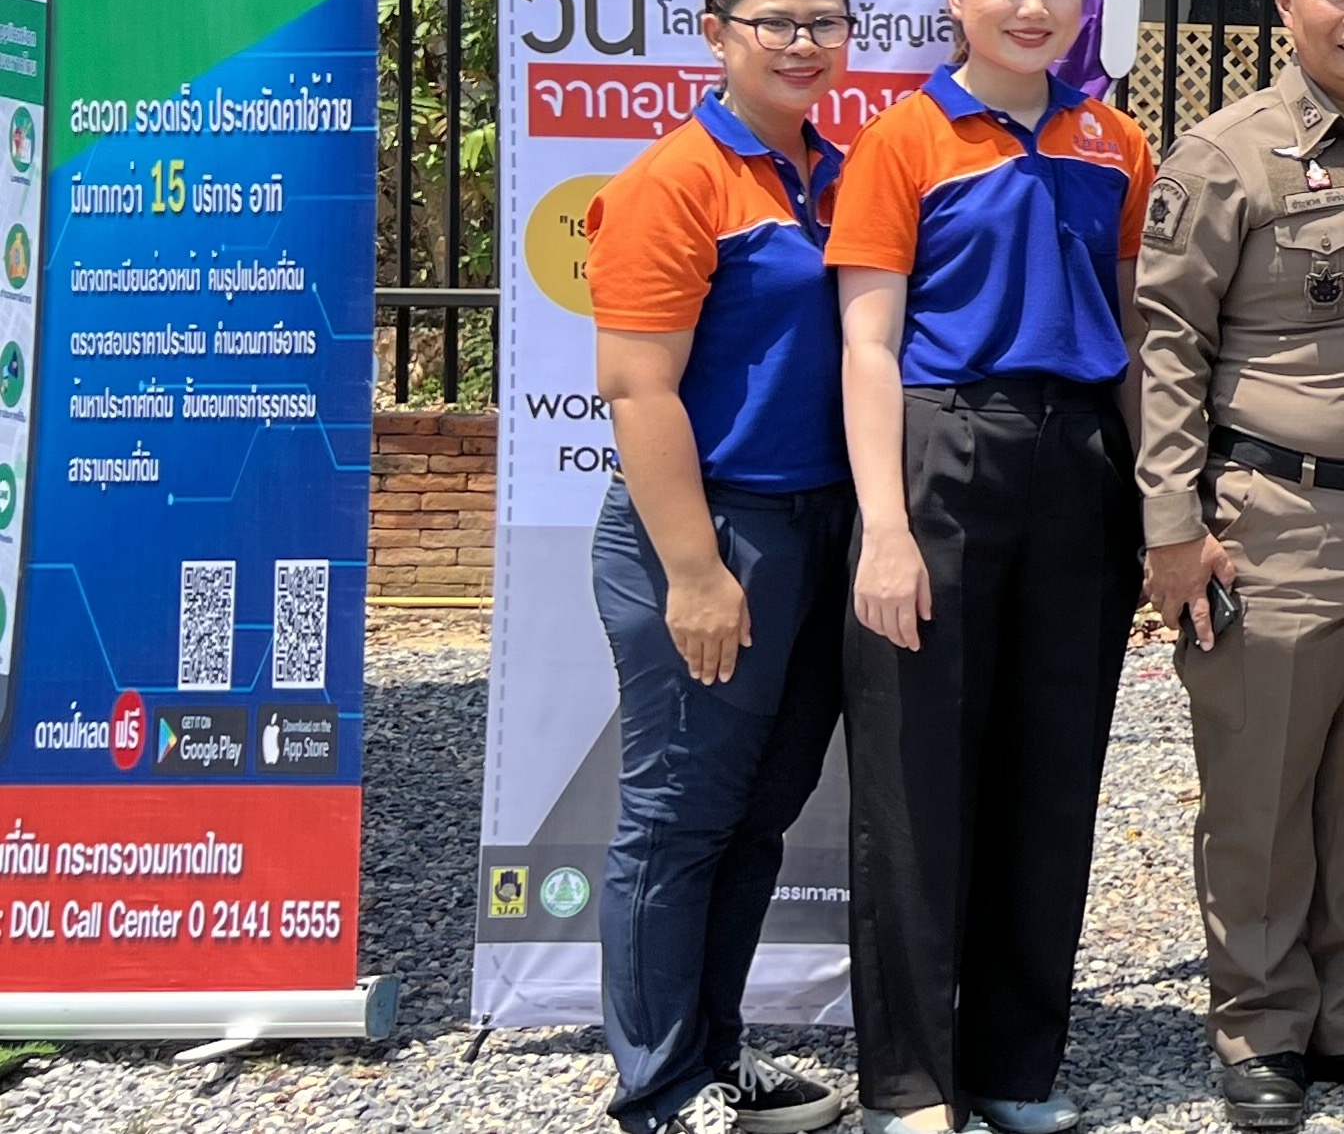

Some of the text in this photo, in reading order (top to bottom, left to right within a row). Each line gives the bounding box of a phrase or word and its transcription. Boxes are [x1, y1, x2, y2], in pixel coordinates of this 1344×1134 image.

[71, 72, 353, 133] สะดวก รวดเร็ว ประหยัดค่าใช้จ่าย
[71, 159, 284, 214] มีมากกว่า 15 บริการ อาทิ
[71, 320, 316, 356] ตรวจสอบราคาประเมิน คำนวณภาษีอากร
[525, 393, 612, 421] WOR
[68, 440, 159, 491] สารานุกรมที่ดิน
[35, 702, 139, 751] ดาวน์โหลด ฟรี
[180, 734, 243, 767] Google Play
[283, 737, 329, 763] App Store
[0, 818, 244, 875] ที่ดิน กระทรวงมหาดไทย
[10, 900, 341, 940] DOL Call Center 0 2141 5555
